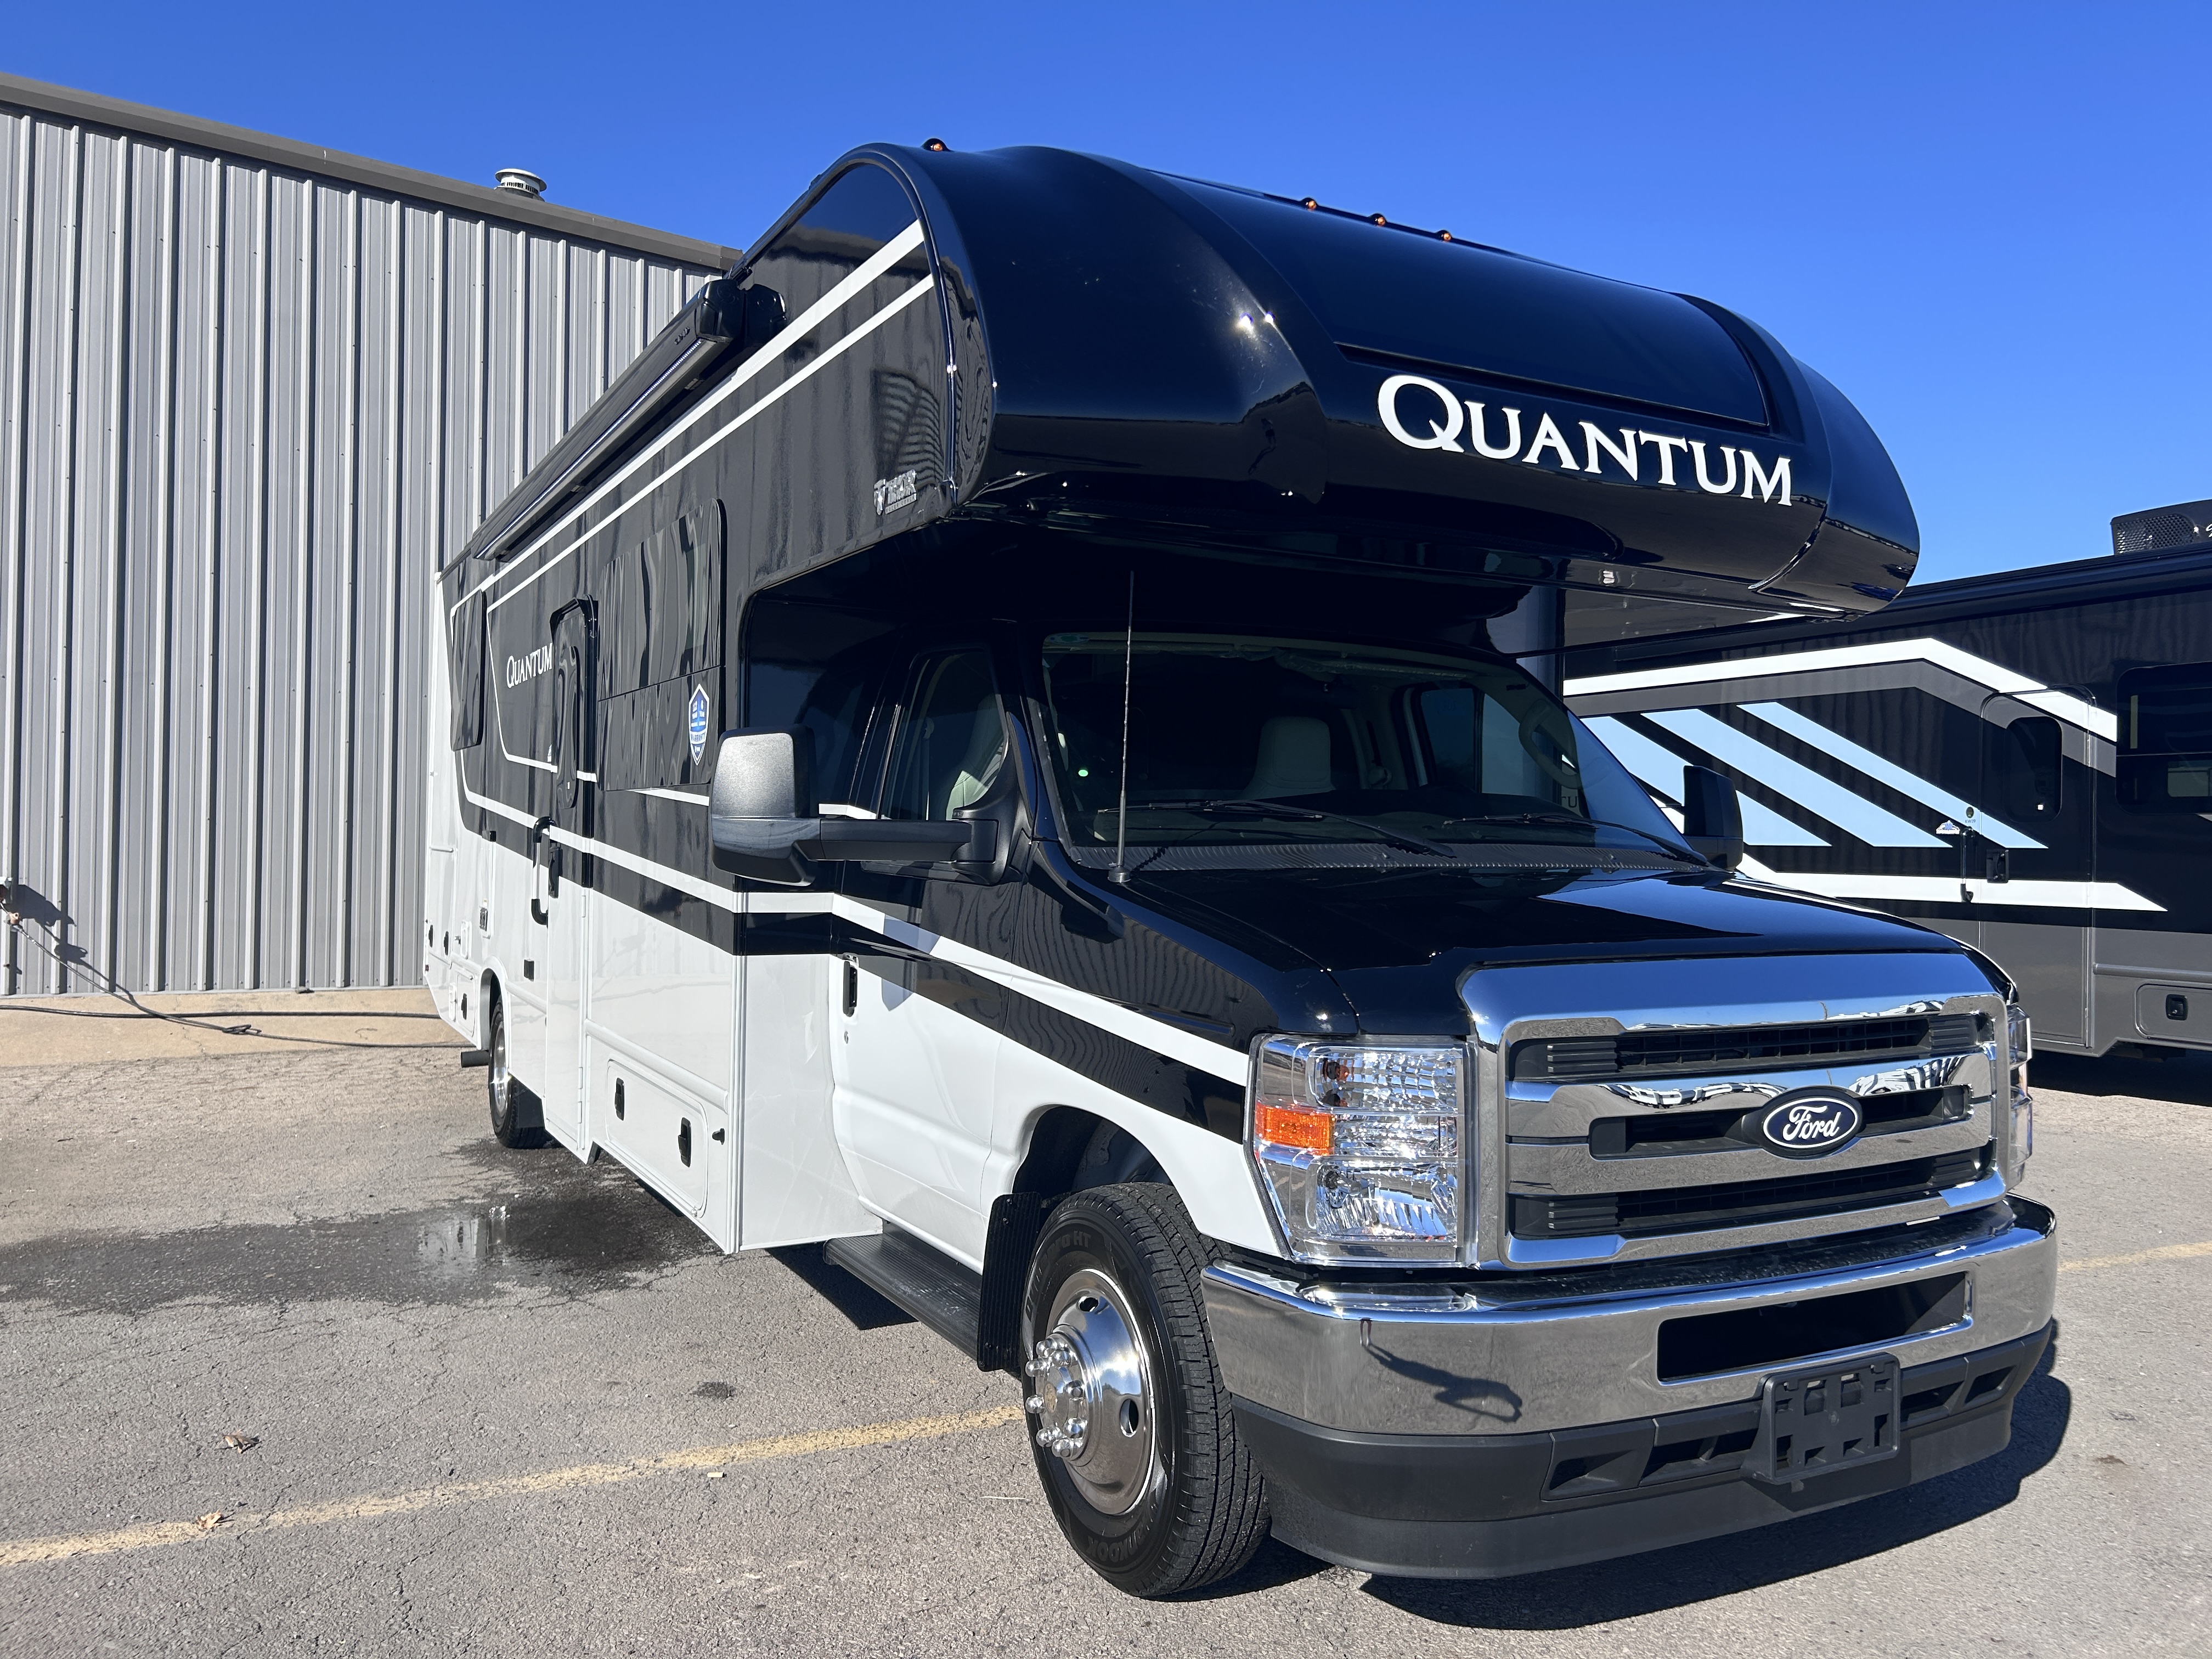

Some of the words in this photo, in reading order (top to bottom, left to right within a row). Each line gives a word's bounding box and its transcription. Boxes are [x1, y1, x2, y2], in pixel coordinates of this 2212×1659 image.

[1376, 375, 1792, 506] QUANTUM
[506, 642, 552, 689] QUANTUM
[1783, 1105, 1841, 1141] Ford
